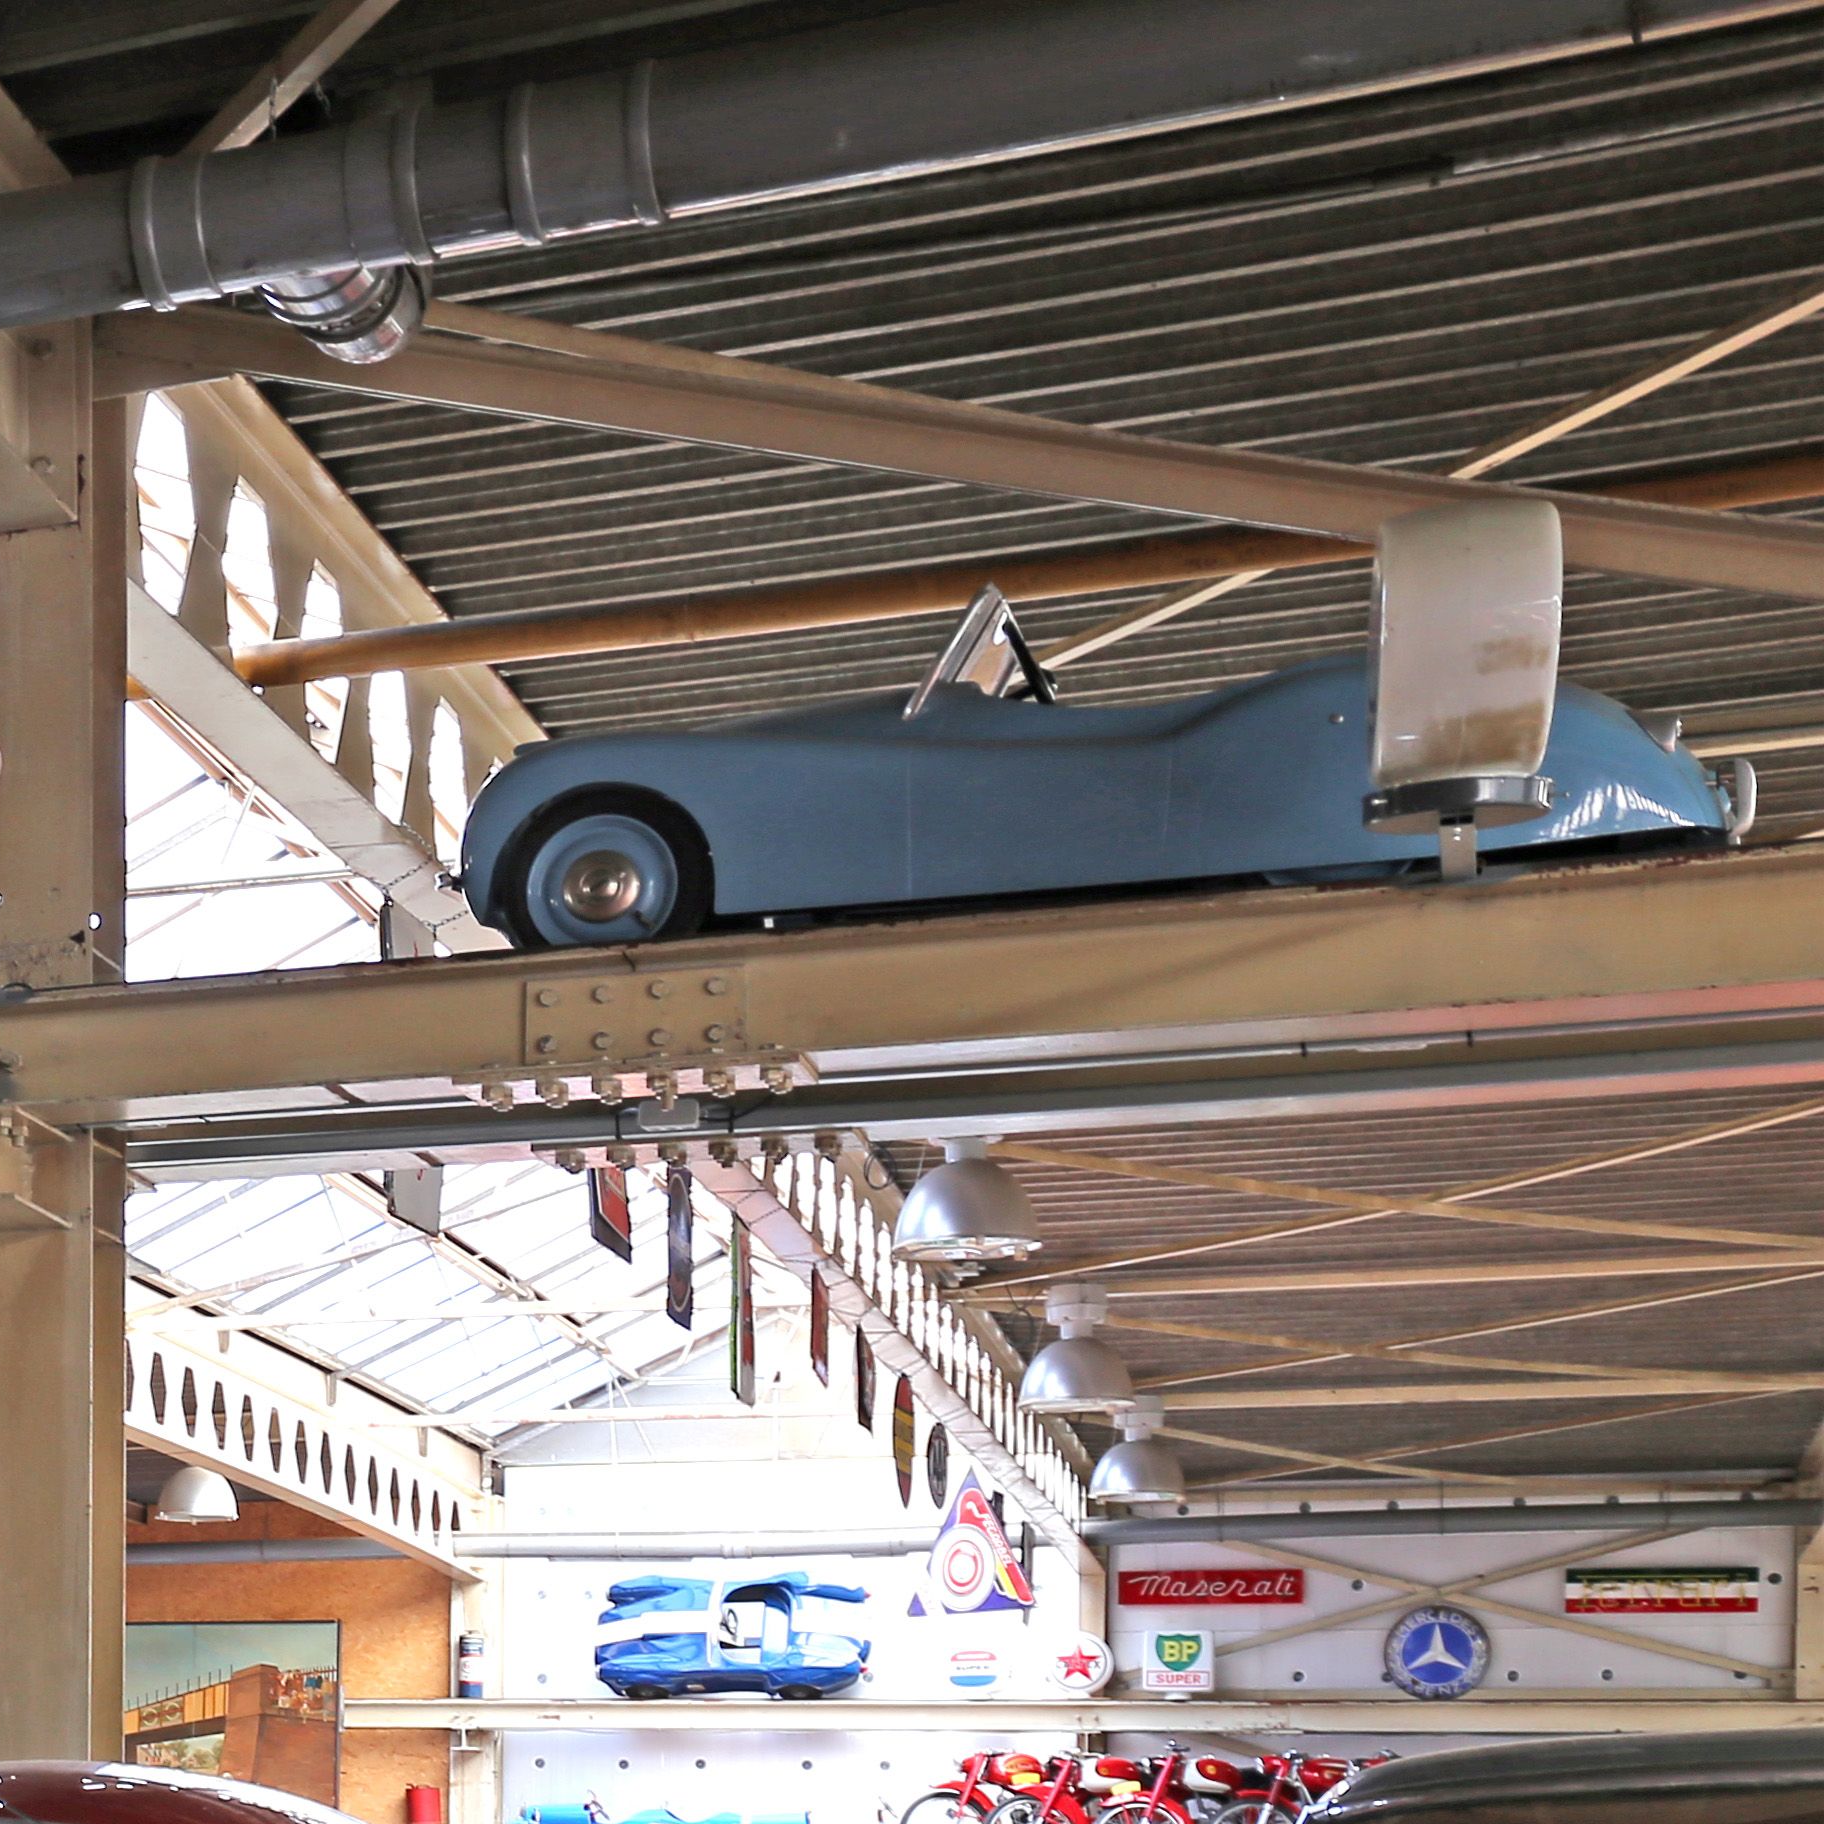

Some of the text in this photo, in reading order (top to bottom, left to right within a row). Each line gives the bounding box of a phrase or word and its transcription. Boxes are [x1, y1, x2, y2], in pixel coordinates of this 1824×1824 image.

[1128, 1572, 1296, 1601] Maserati
[1162, 1640, 1202, 1663] BP
[1155, 1673, 1201, 1685] SUPER
